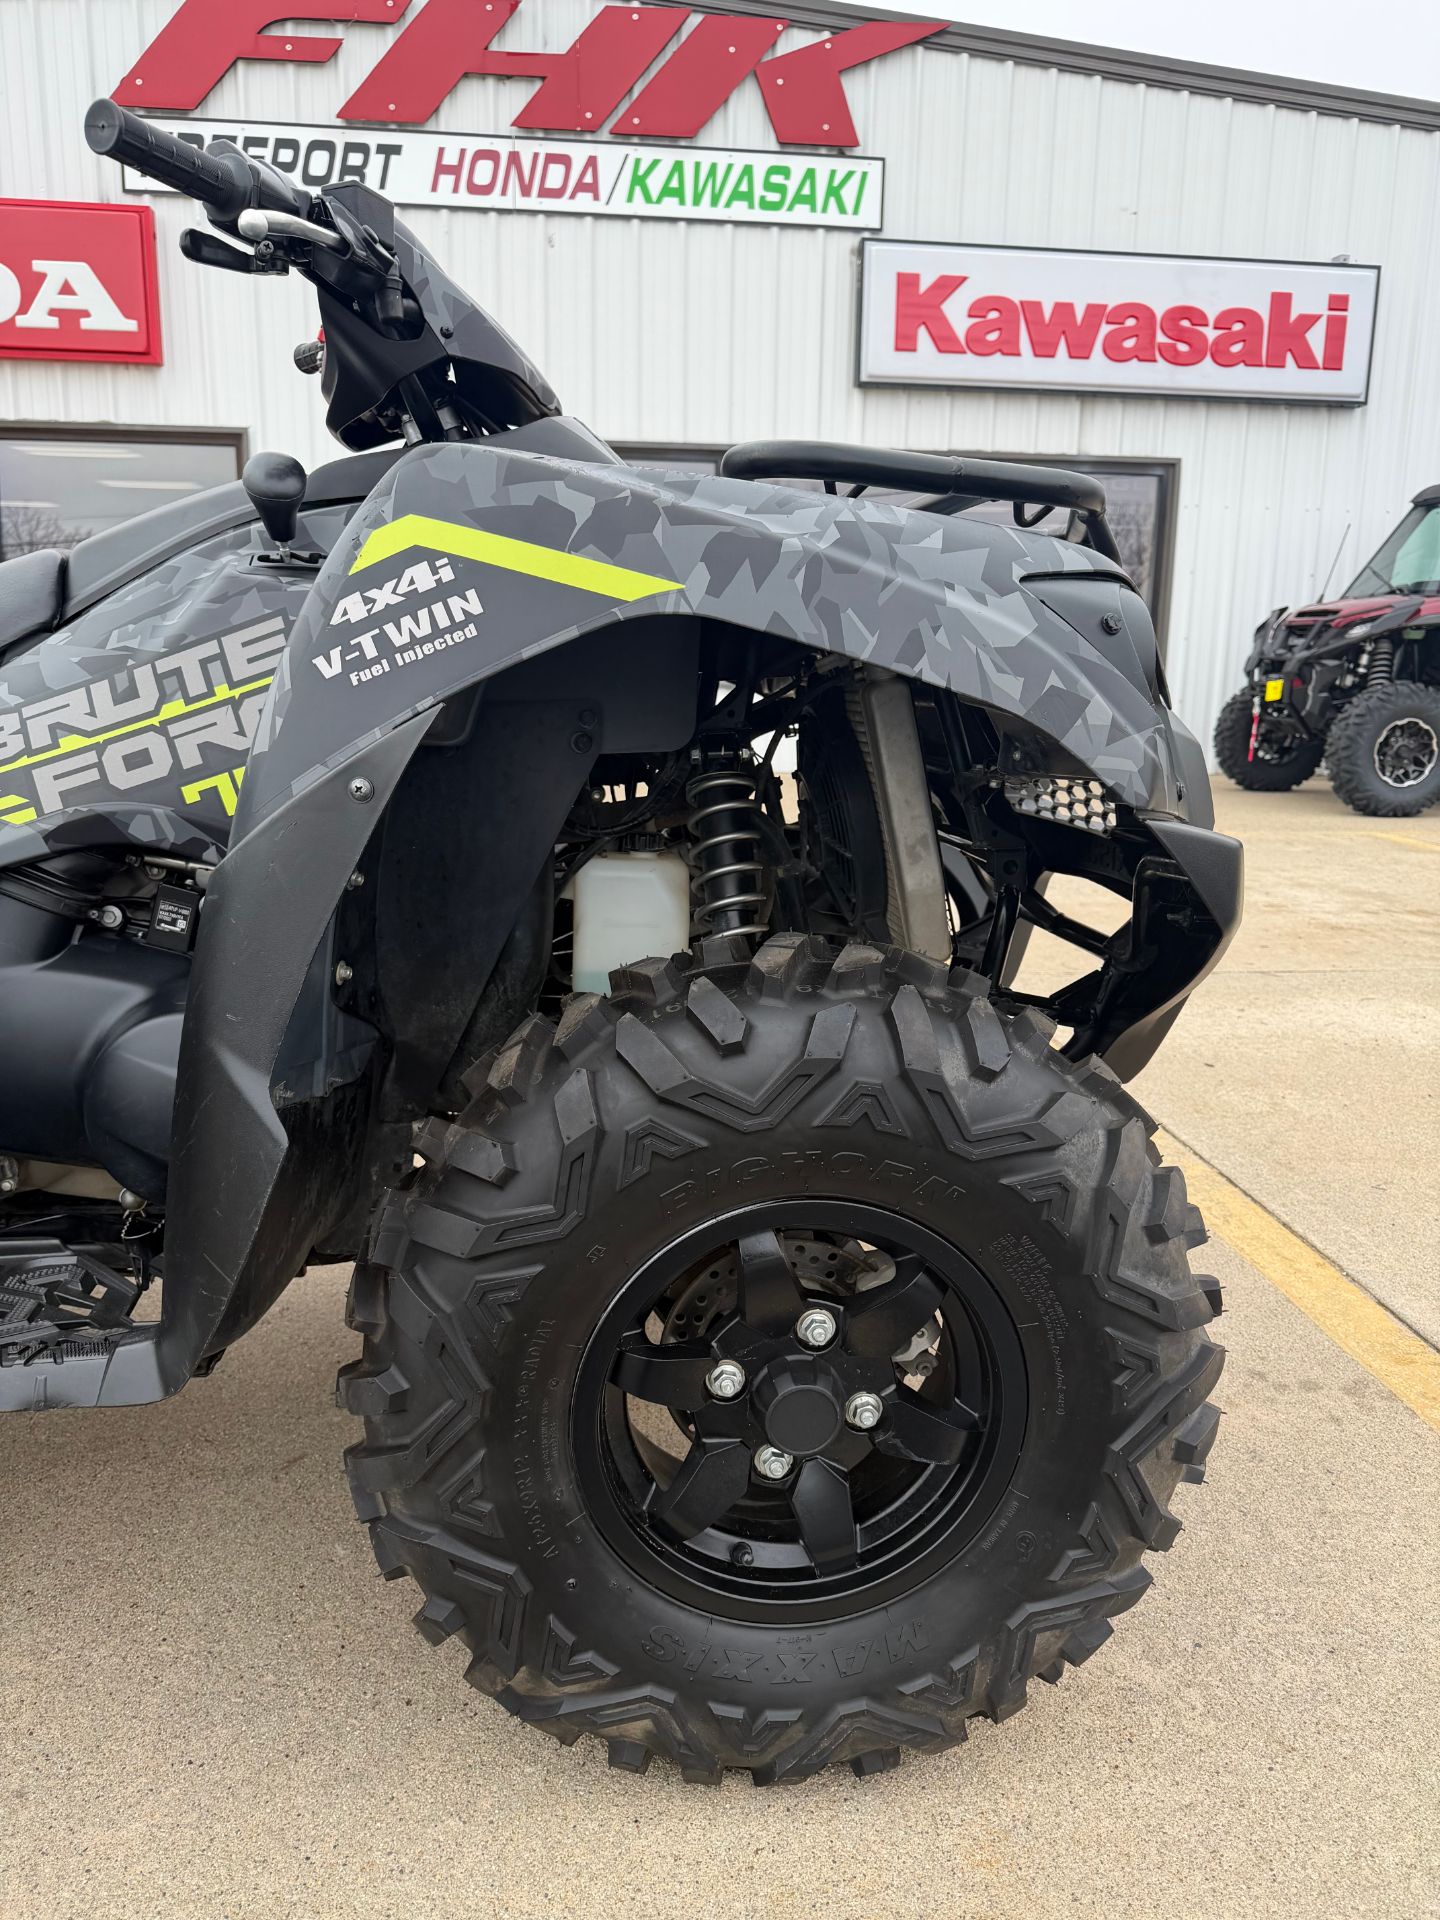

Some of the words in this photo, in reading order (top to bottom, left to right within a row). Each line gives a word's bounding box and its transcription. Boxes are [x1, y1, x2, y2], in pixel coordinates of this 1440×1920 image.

[111, 0, 950, 148] FHK
[0, 259, 139, 332] A
[893, 271, 1351, 372] Kawasaki
[329, 557, 456, 626] 4x4i
[311, 588, 484, 680] V-TWIN
[349, 658, 391, 687] Fuel
[394, 622, 478, 667] Injected
[181, 766, 246, 817] 7
[641, 1617, 932, 1686] MAXXIS
